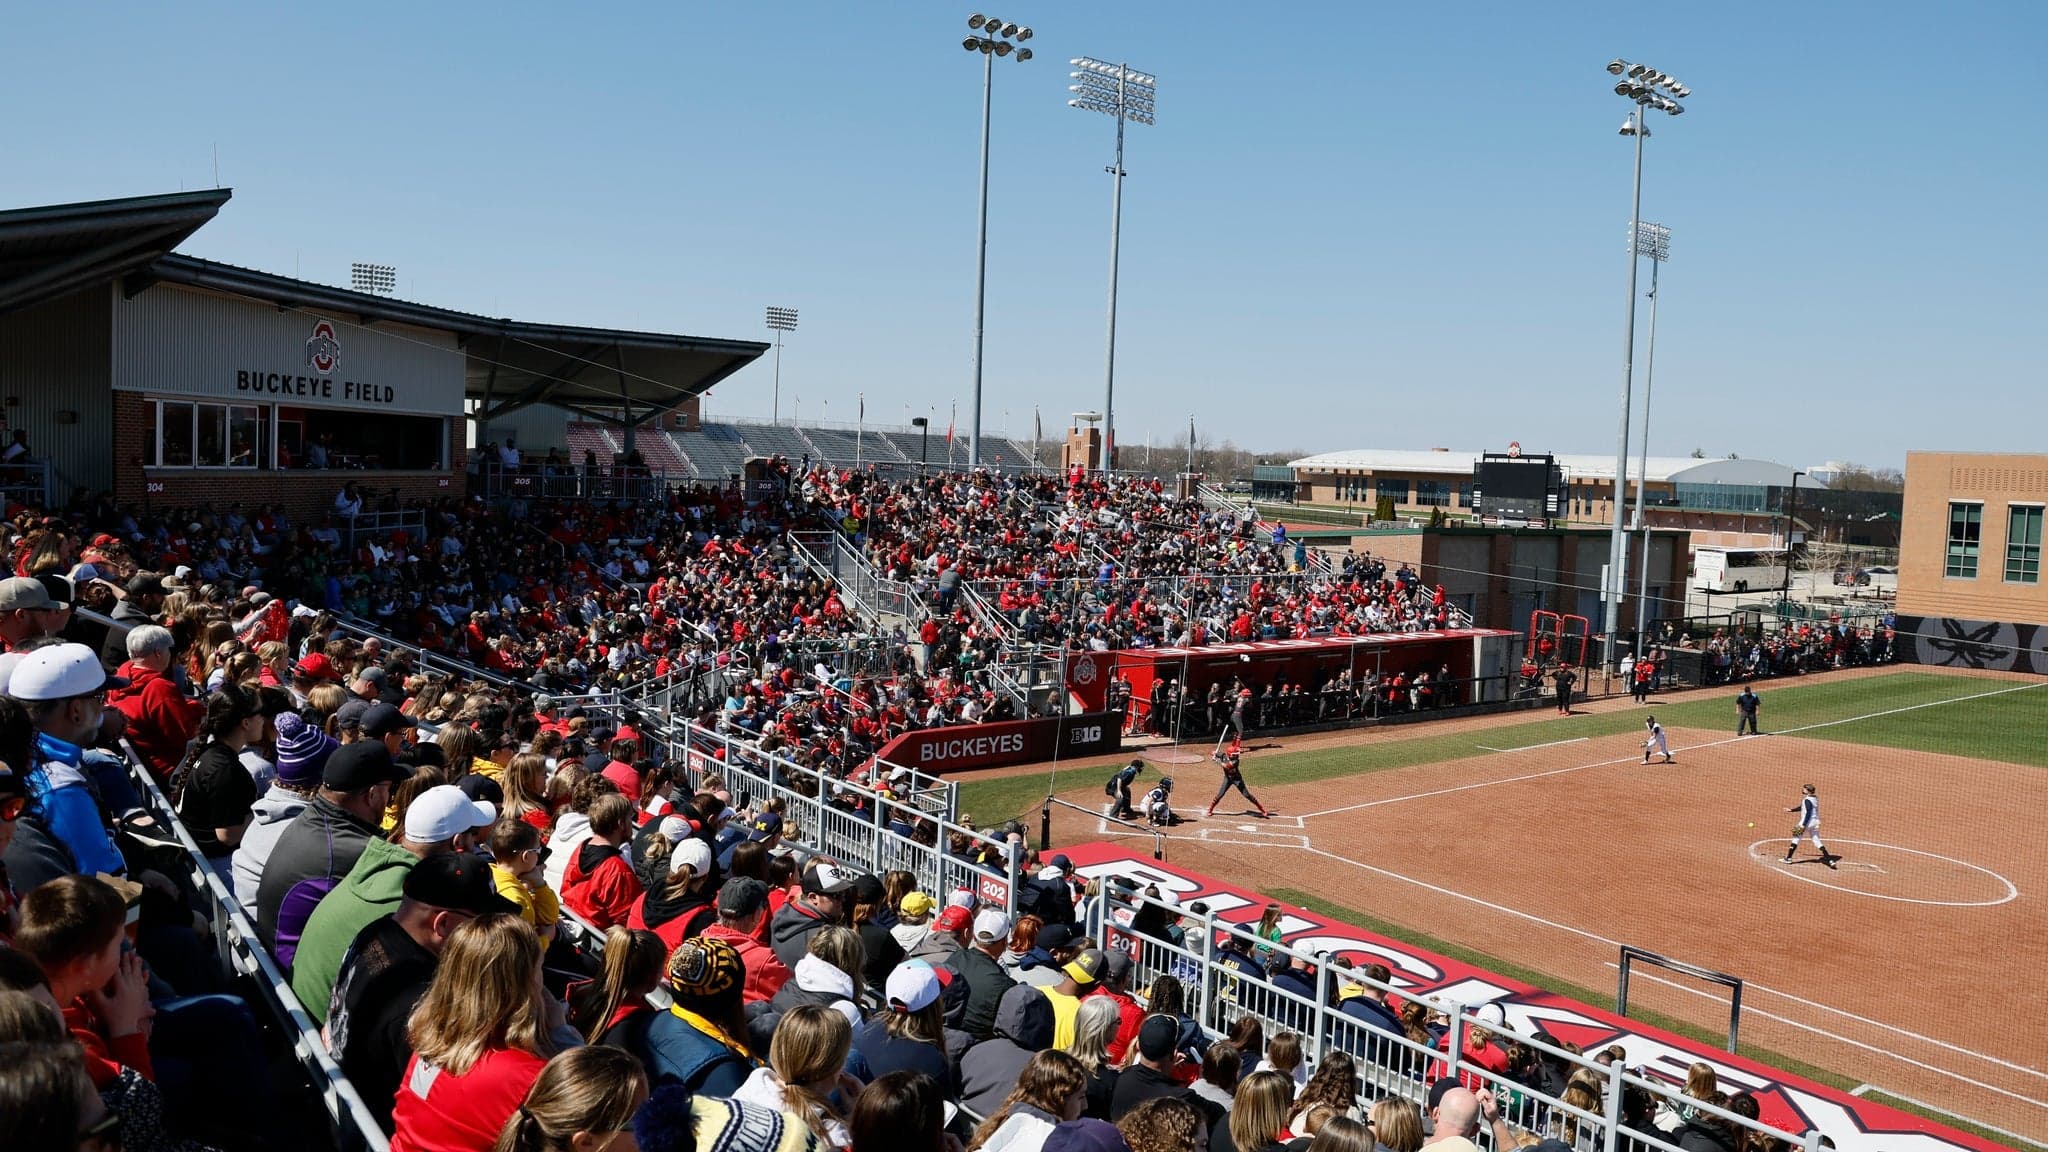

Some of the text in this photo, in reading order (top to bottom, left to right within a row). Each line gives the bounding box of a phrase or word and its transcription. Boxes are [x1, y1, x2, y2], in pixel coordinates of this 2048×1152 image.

[237, 370, 394, 404] BUCKEYE FIELD
[147, 482, 163, 492] 304
[920, 733, 1024, 762] BUCKEYES
[690, 756, 703, 770] 202
[983, 880, 1006, 901] 202
[1110, 933, 1137, 955] 201
